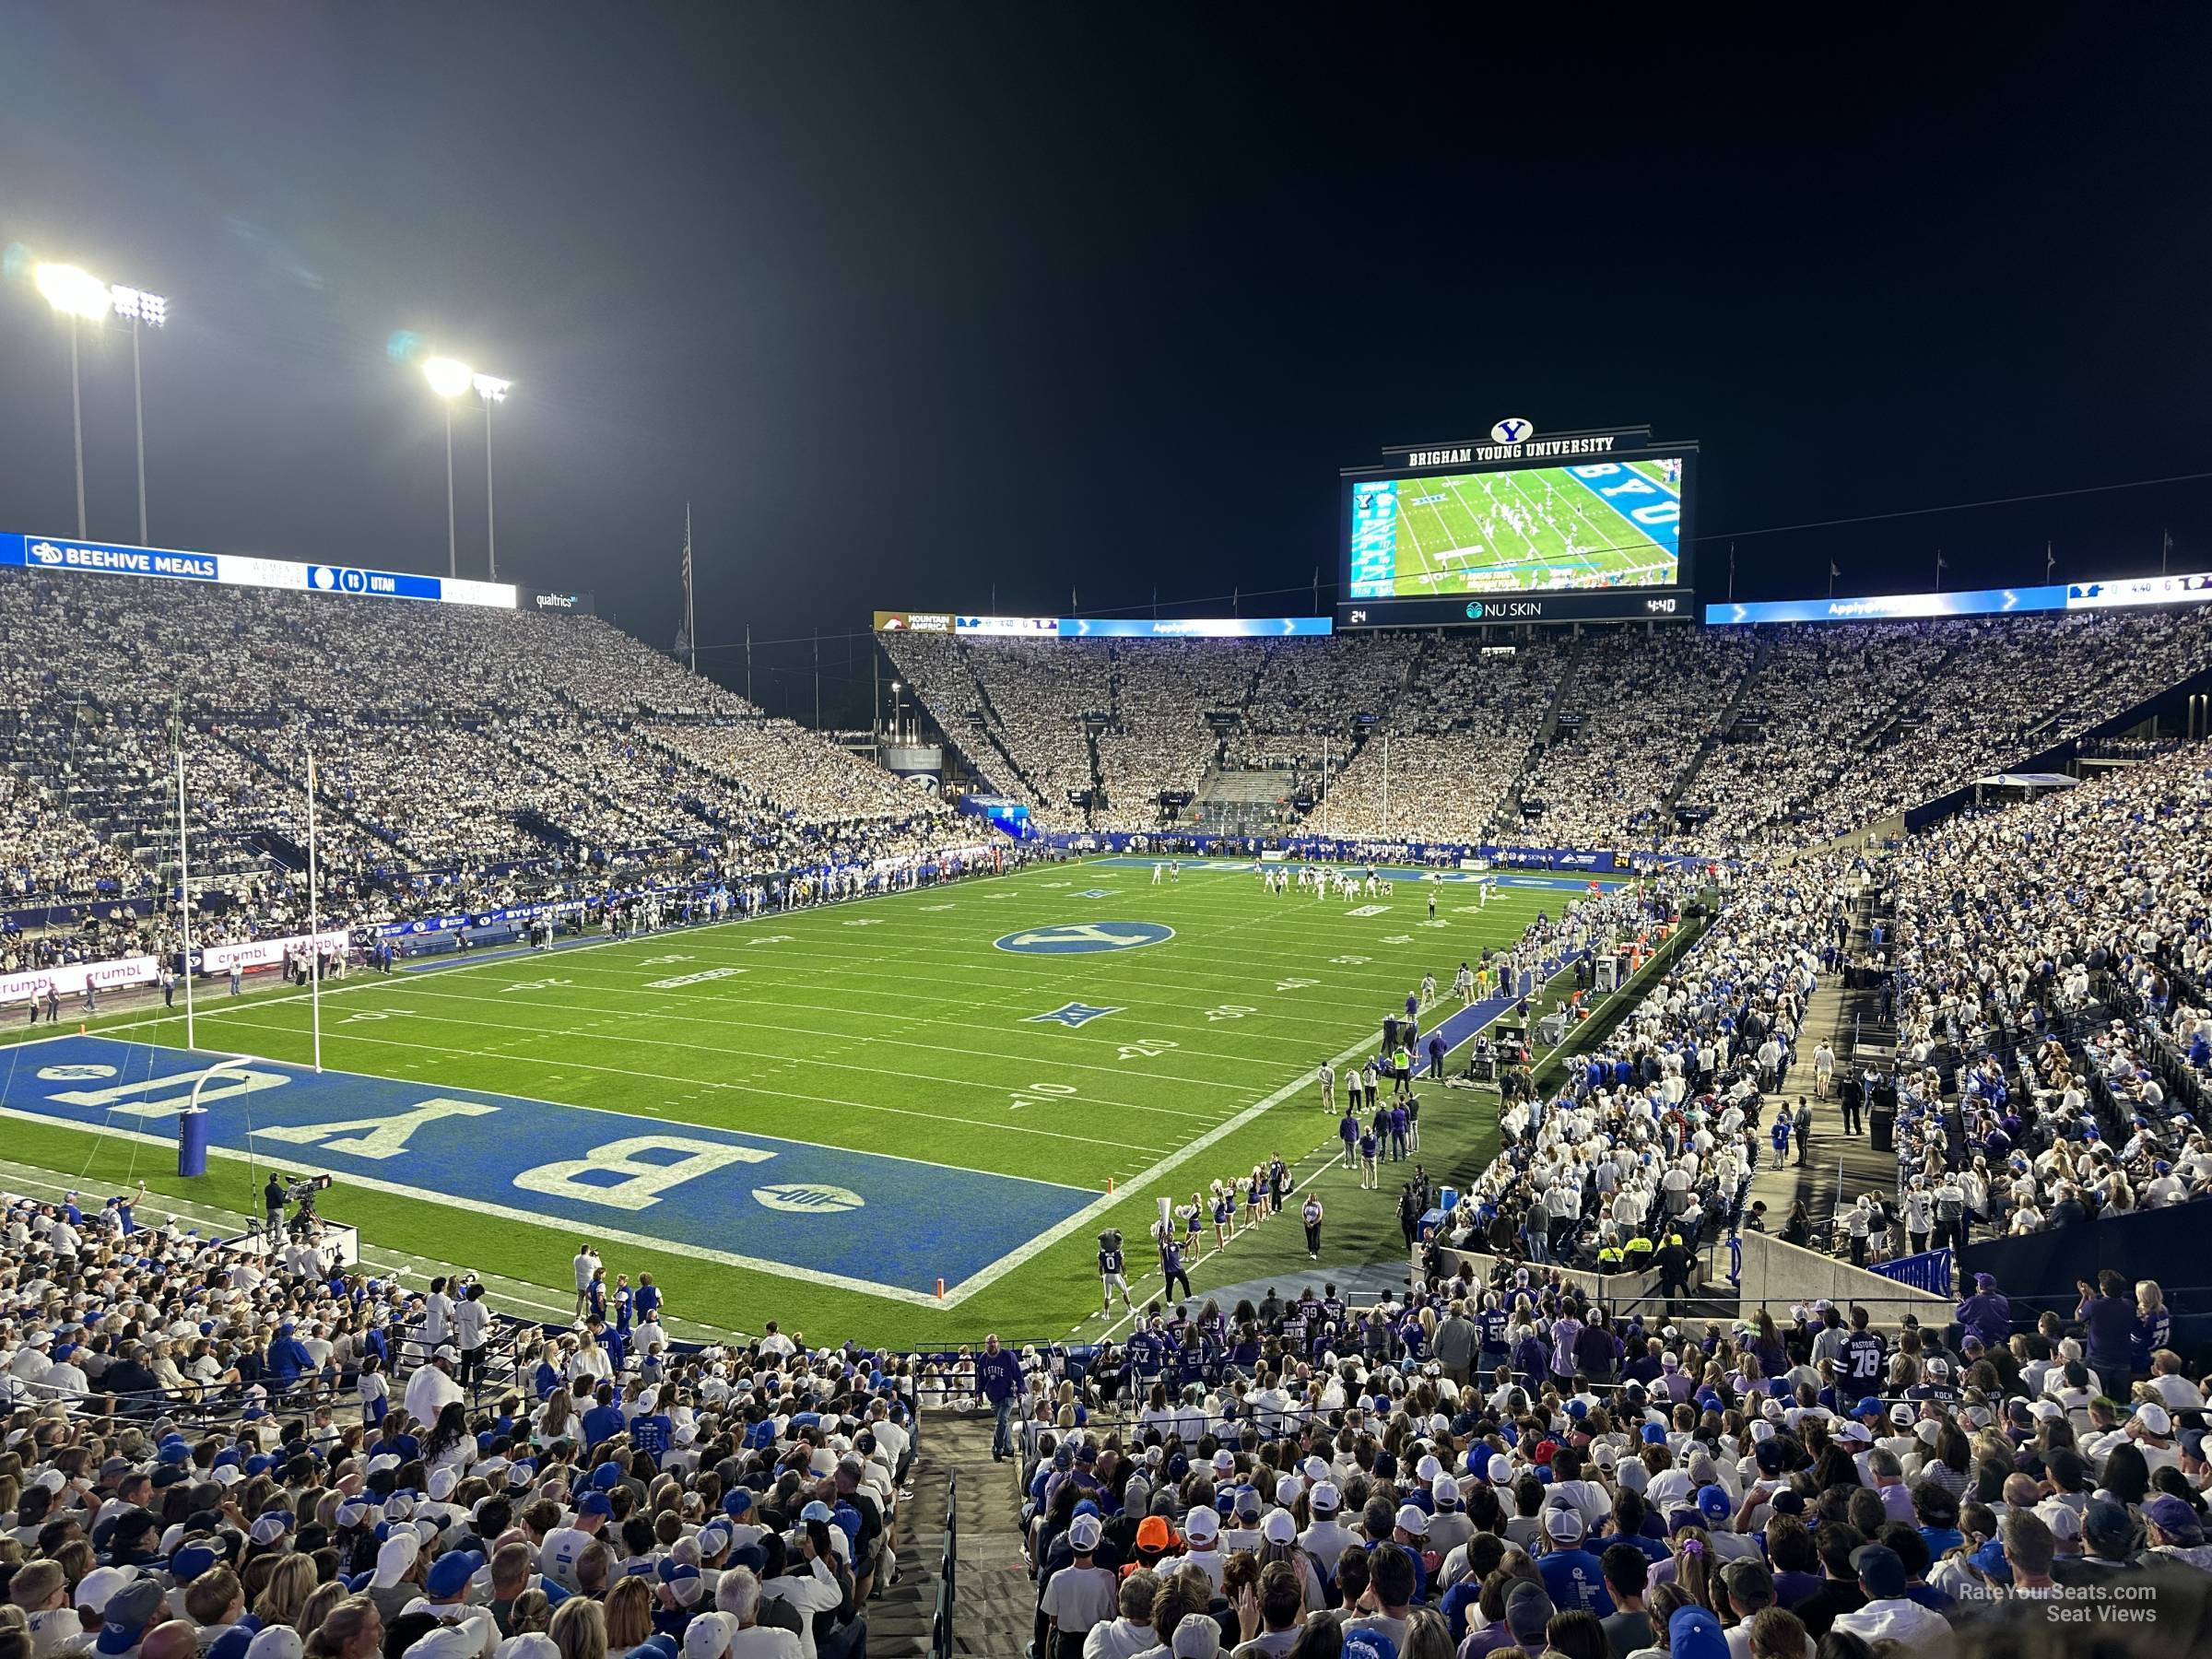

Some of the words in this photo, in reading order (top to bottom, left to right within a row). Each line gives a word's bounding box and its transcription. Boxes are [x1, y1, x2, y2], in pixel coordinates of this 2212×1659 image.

[1498, 420, 1525, 441] Y
[1409, 449, 1471, 467] BRIGHAM
[1477, 443, 1522, 460] YOUNG
[1526, 437, 1614, 456] UNIVERSITY
[66, 547, 150, 571] BEEHIVE
[155, 557, 215, 576] MEALS
[347, 574, 359, 589] VS
[371, 577, 395, 593] UTAH
[536, 593, 571, 608] qualtrics
[1647, 599, 1676, 612] 4:40
[1351, 611, 1366, 622] 24
[1485, 604, 1506, 617] NU
[1510, 603, 1542, 616] SKIN
[908, 615, 949, 624] MOUNTAIN
[911, 622, 947, 630] AMERICA
[1615, 857, 1629, 867] 24
[94, 964, 142, 981] rumbl
[0, 976, 53, 994] rumbl
[1204, 1005, 1259, 1019] 30
[1117, 1039, 1180, 1058] 20
[1009, 1083, 1077, 1103] 10
[1778, 1130, 1783, 1139] 1
[1106, 1256, 1115, 1270] 0
[1301, 1307, 1318, 1319] 99
[1851, 1340, 1877, 1350] PASTORE
[1850, 1349, 1880, 1378] 78
[987, 1365, 1004, 1377] STATE
[1934, 1391, 1953, 1400] KOCH
